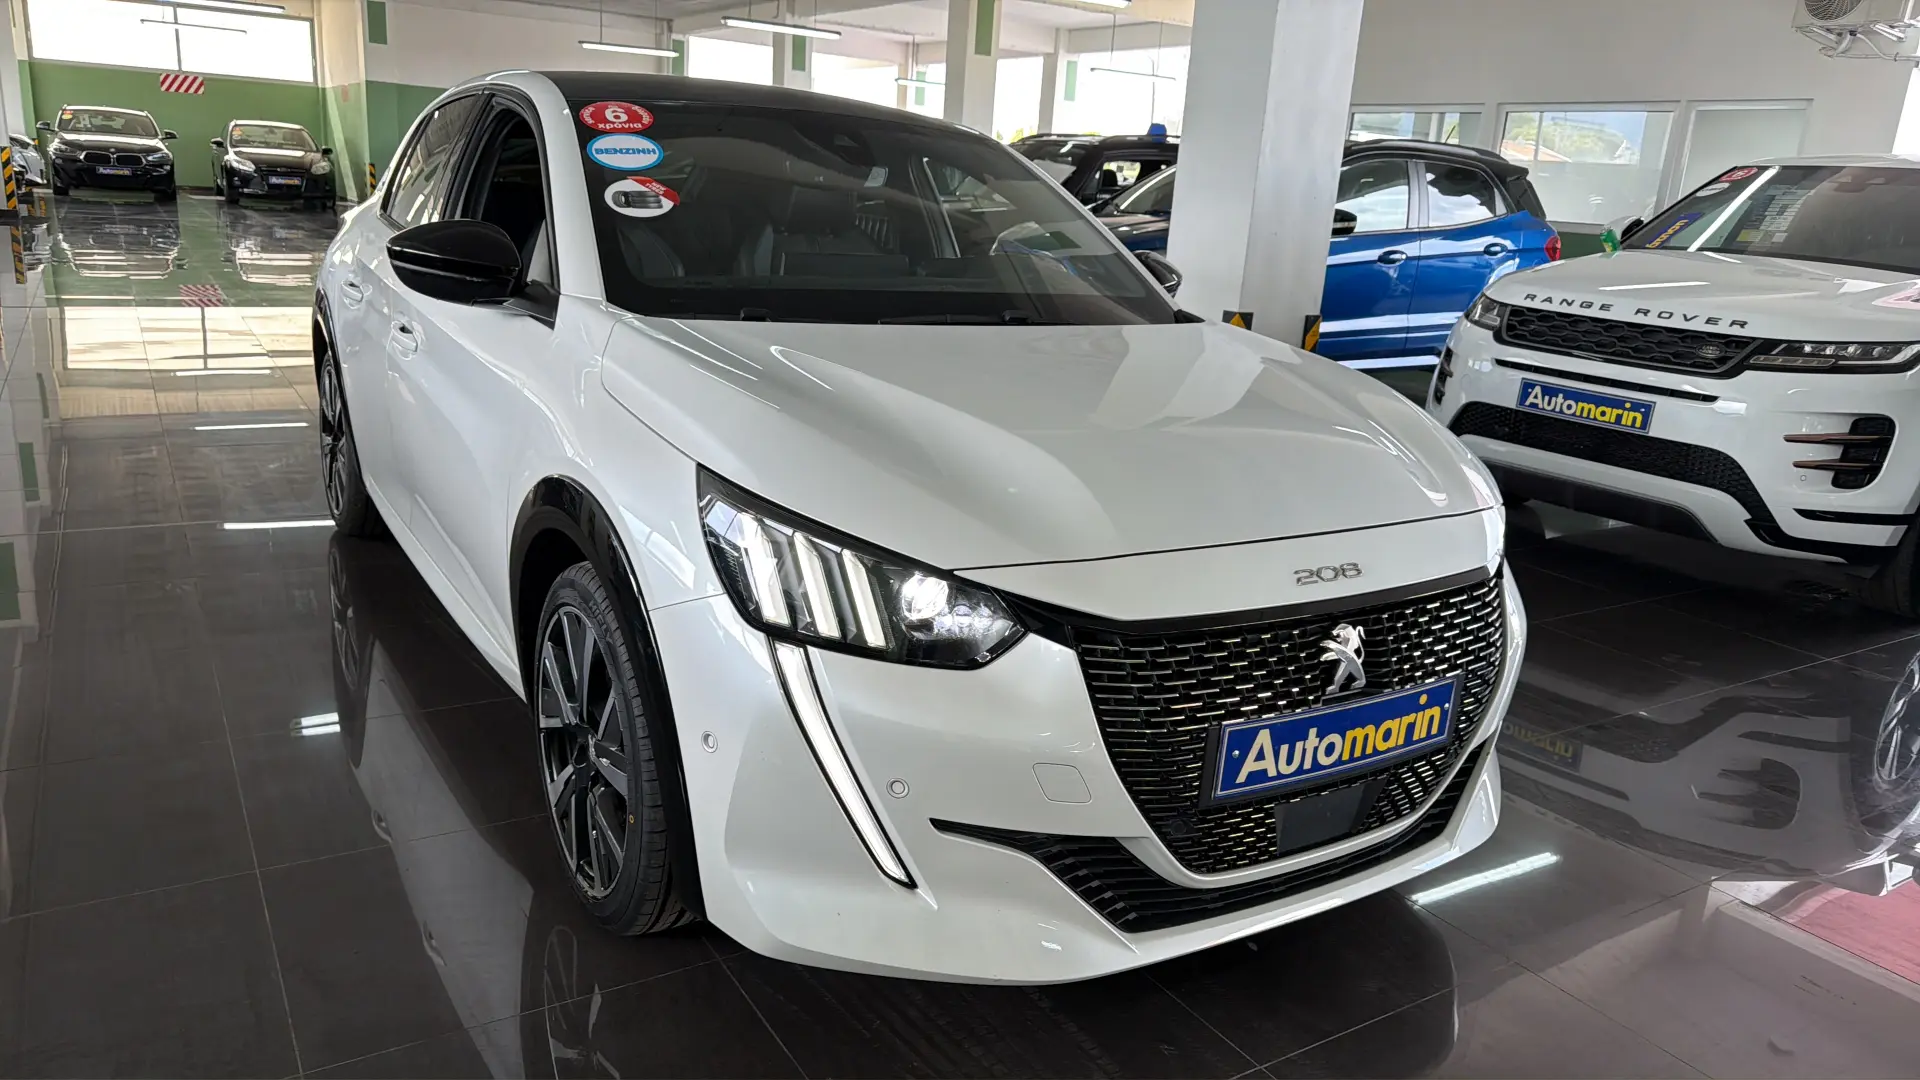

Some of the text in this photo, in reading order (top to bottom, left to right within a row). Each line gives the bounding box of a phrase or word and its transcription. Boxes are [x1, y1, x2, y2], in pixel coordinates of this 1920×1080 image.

[604, 108, 629, 123] 6
[594, 147, 657, 155] ΒΕΝΖΙΝΗ
[1523, 293, 1749, 330] RANGE ROVER
[1524, 384, 1643, 429] Automarin
[1293, 562, 1364, 586] 208
[1235, 693, 1441, 784] Automarin
